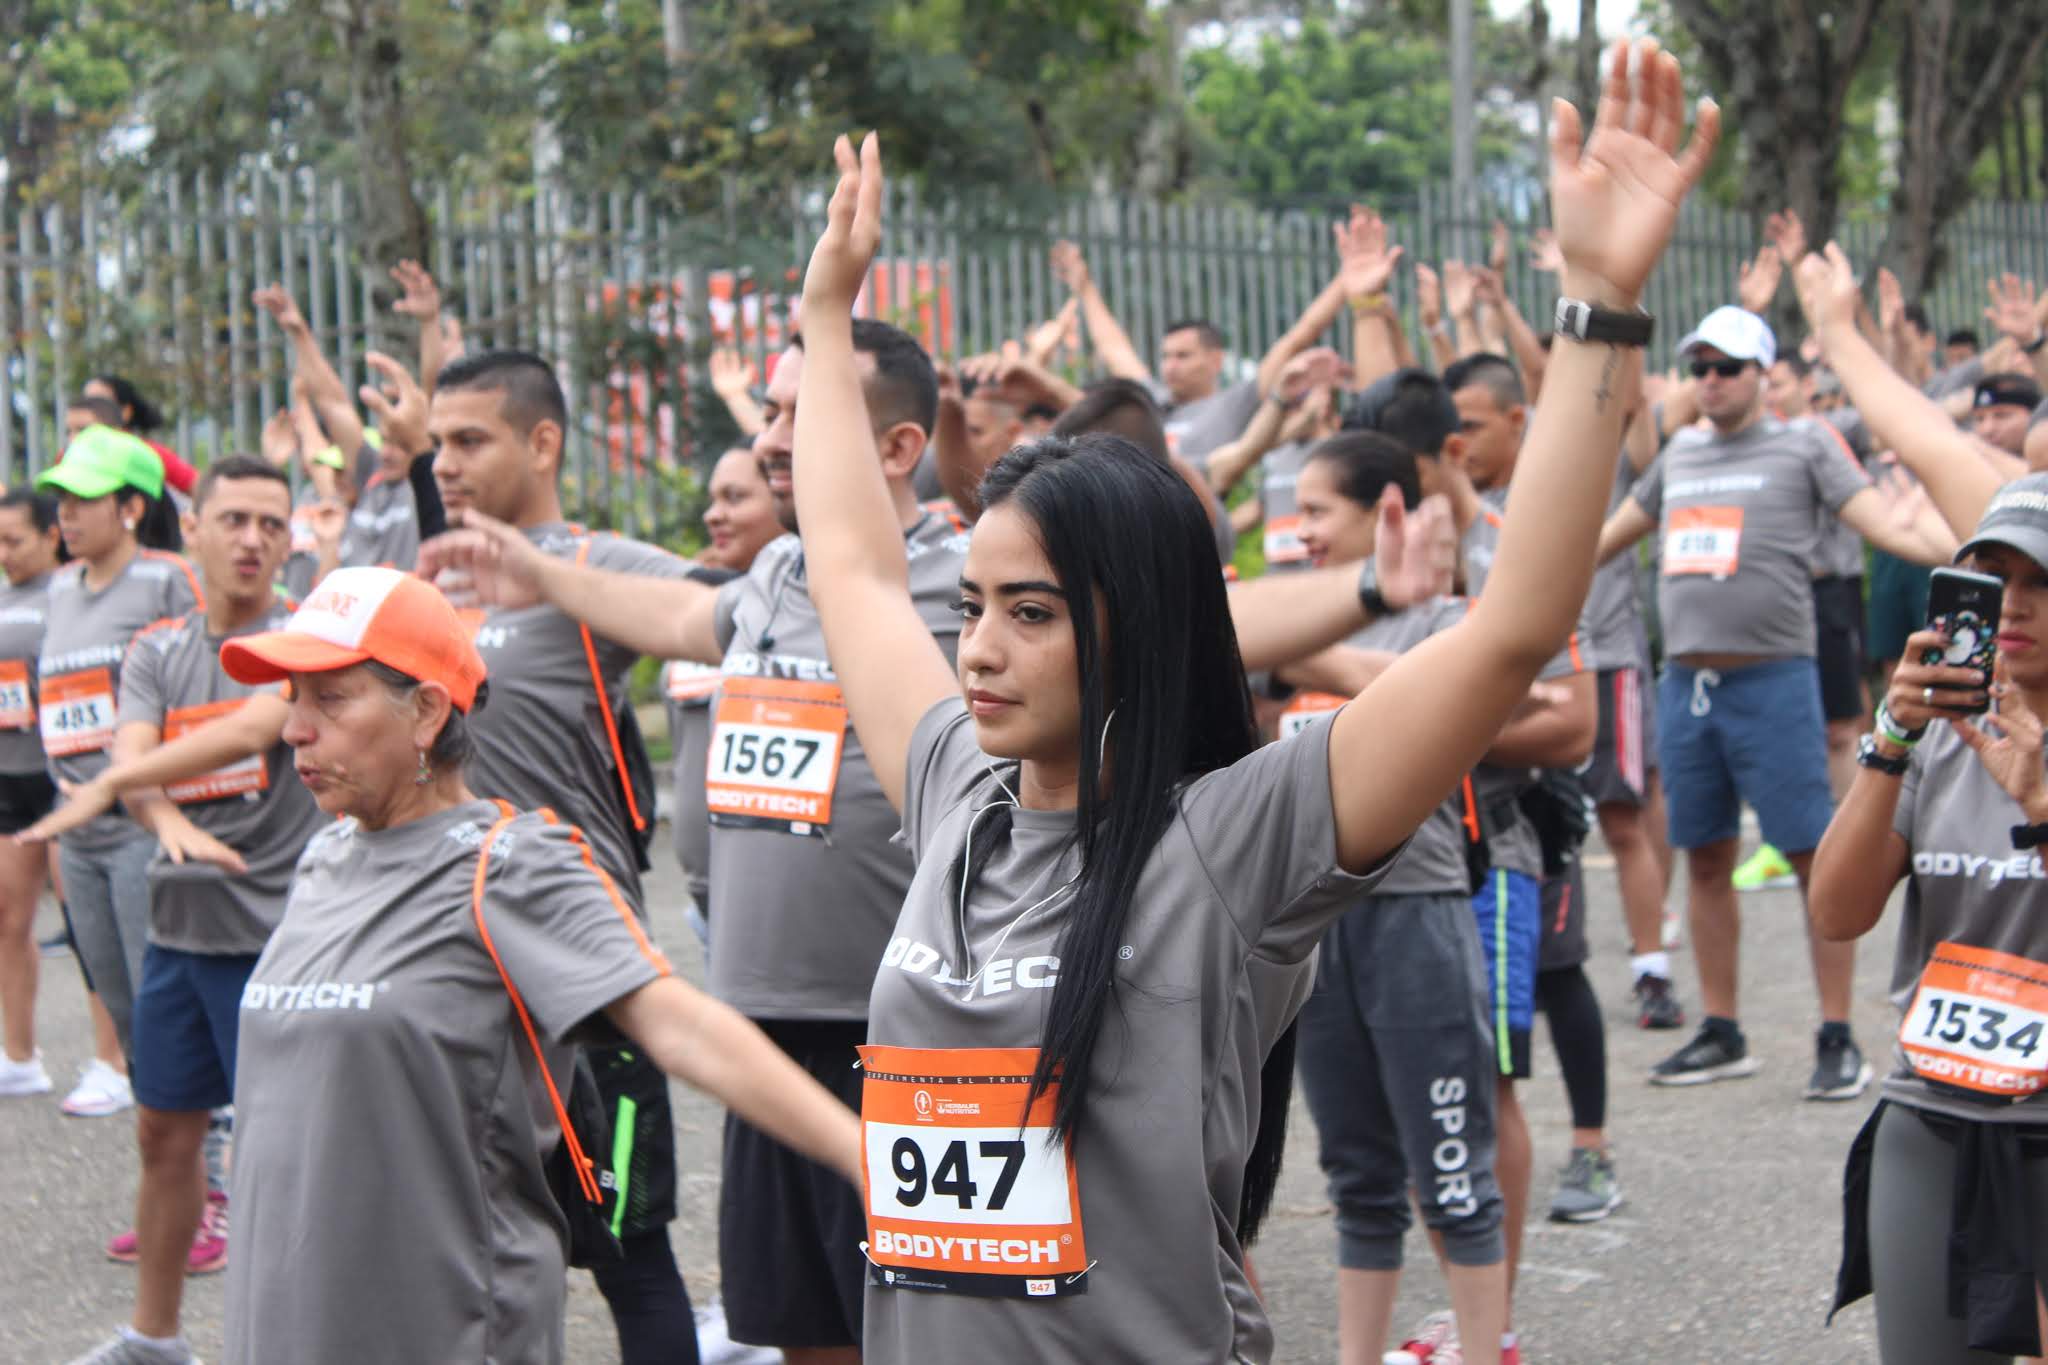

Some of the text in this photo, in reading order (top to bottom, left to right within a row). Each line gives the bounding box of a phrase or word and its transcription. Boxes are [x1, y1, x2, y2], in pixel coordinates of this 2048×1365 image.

[723, 732, 821, 779] 1567
[240, 981, 375, 1010] DYTECH
[1923, 998, 2045, 1058] 1534
[866, 1071, 944, 1084] EXPERIMENTA
[891, 1137, 1026, 1211] 947
[1030, 1282, 1051, 1293] 947
